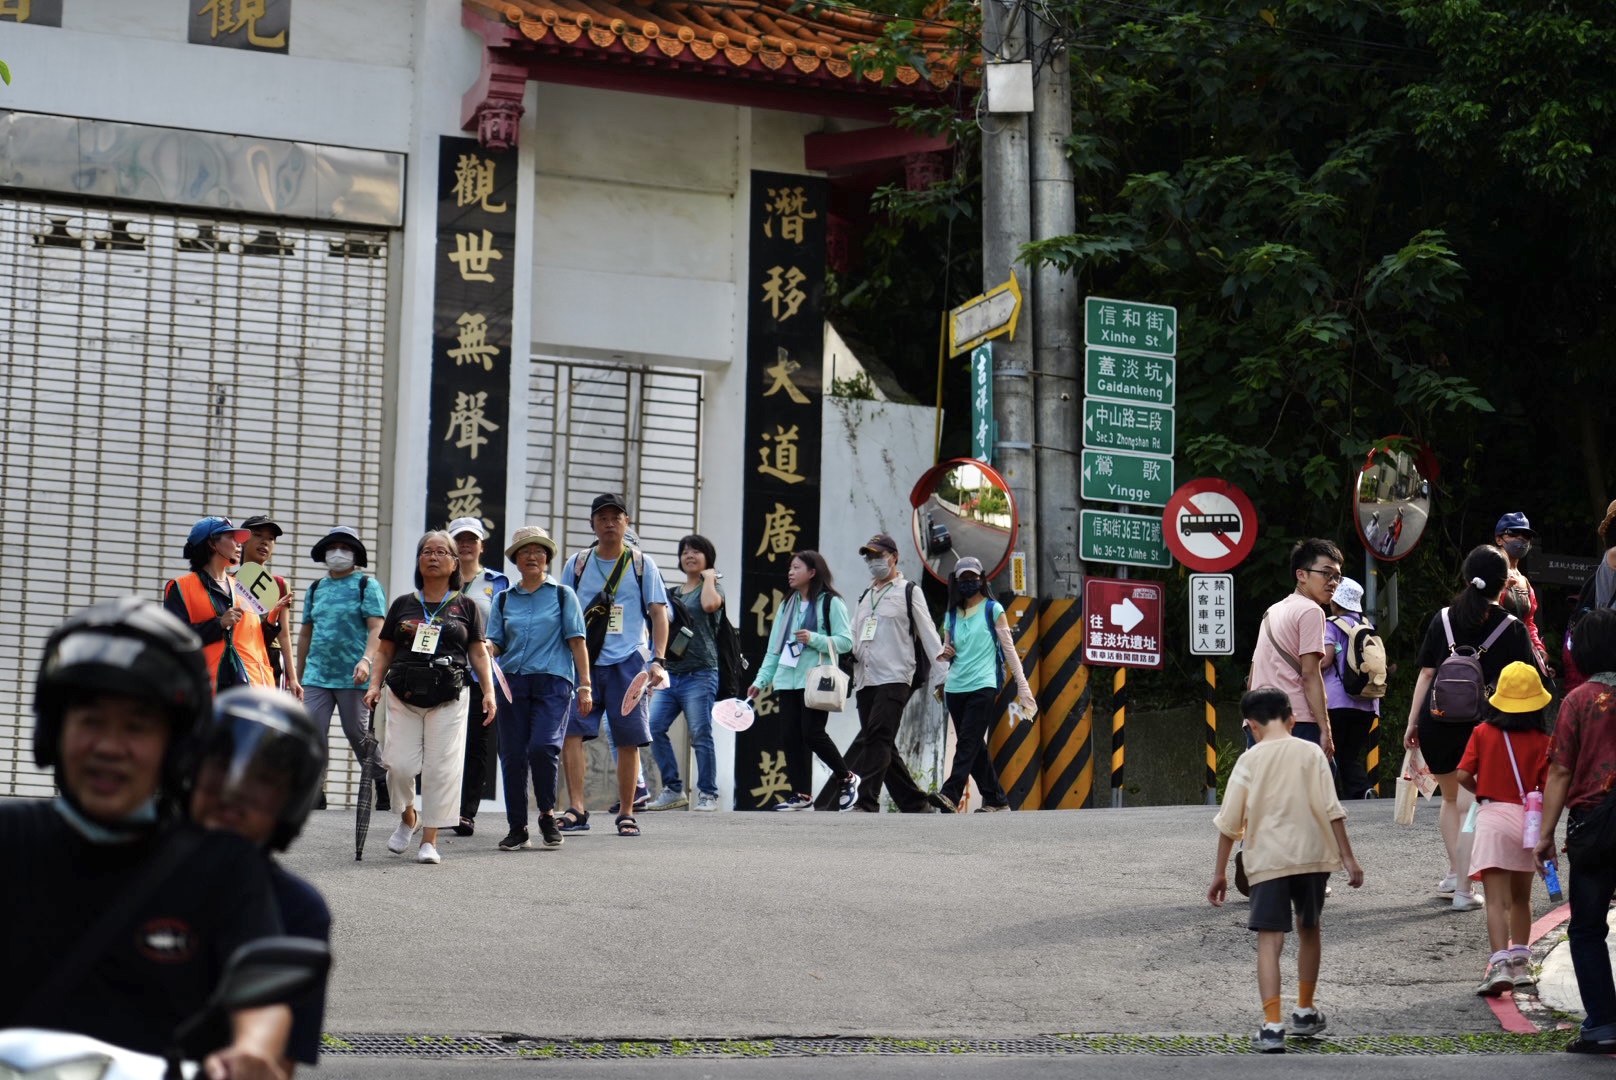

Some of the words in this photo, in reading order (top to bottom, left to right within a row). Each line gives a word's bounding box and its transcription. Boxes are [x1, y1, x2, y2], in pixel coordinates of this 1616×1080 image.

[1098, 305, 1164, 331] 信和街
[1101, 329, 1136, 344] Xinhe
[1145, 335, 1161, 347] St.
[1098, 355, 1163, 381] 蓋淡坑
[1097, 380, 1163, 401] Gaidankeng
[1096, 405, 1162, 431] 中山路三段
[1117, 433, 1149, 450] Zhongshan
[1108, 483, 1151, 501] Yingge
[1093, 517, 1160, 543] 信和街36至72號
[1128, 548, 1147, 560] Xinhe
[250, 571, 272, 599] E
[1090, 614, 1103, 629] 往
[1198, 580, 1209, 649] 大客車進入
[1214, 580, 1226, 649] 禁止甲乙類
[421, 635, 431, 647] E
[1090, 631, 1157, 651] 蓋淡坑遺址
